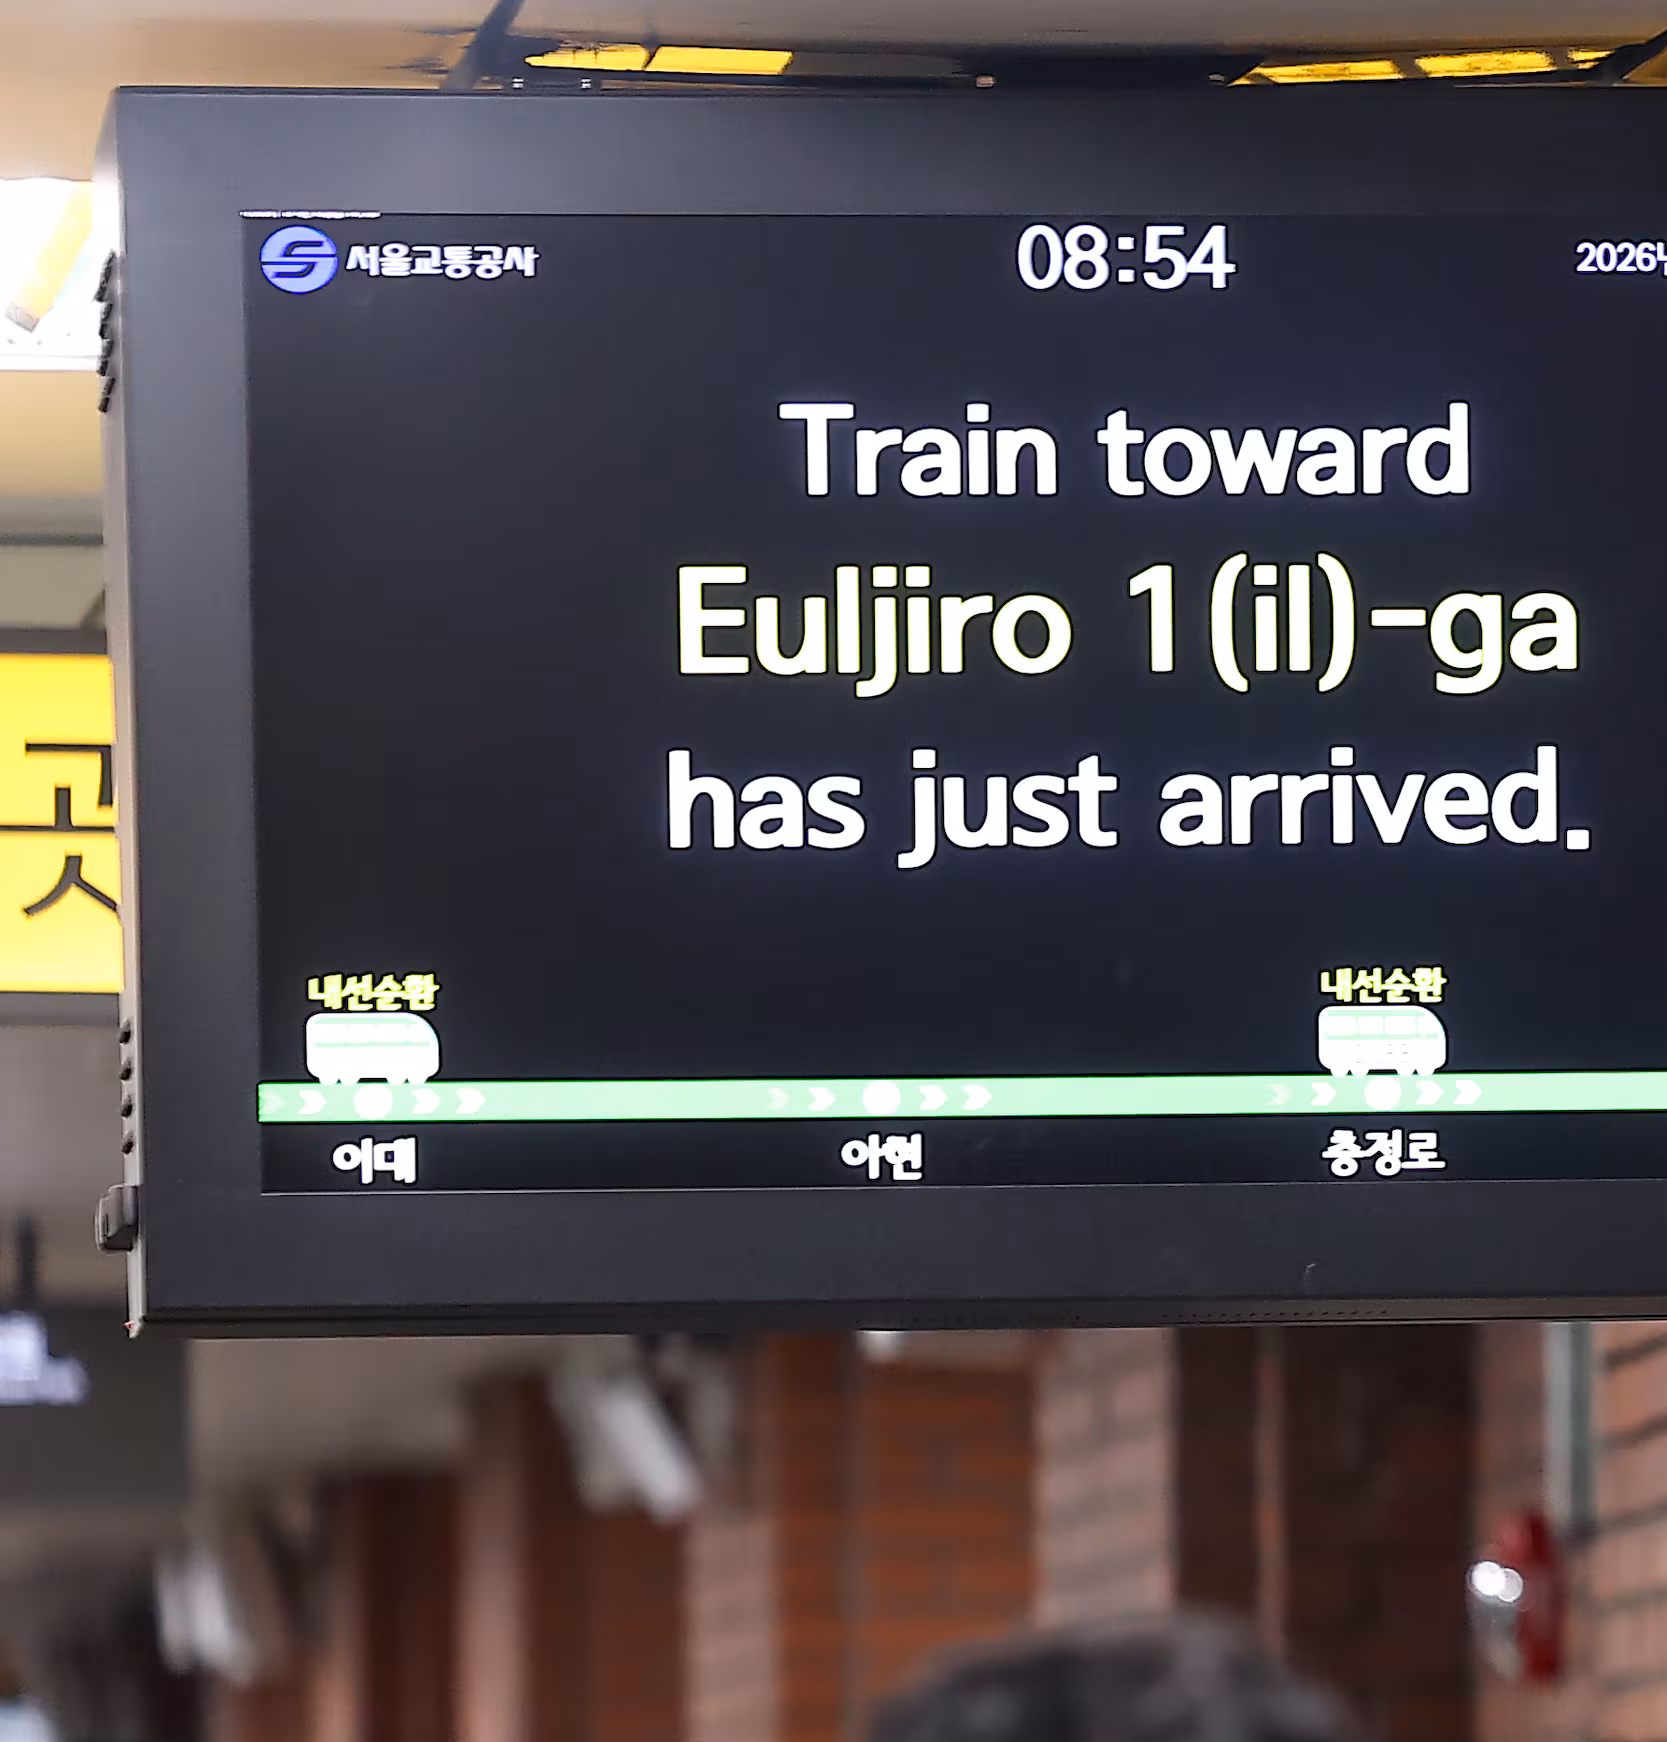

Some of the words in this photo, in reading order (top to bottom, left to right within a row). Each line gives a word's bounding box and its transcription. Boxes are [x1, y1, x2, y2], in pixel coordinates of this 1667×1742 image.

[345, 242, 540, 279] 서울교통공사
[1017, 224, 1236, 290] 08:54
[779, 402, 1057, 497] Train
[1097, 402, 1469, 496] toward
[679, 566, 1072, 698] Euljiro
[1129, 553, 1577, 694] 1(il)-ga
[668, 750, 865, 849] has
[897, 749, 1117, 869] just
[1159, 745, 1590, 850] arrived.
[308, 973, 440, 1011] 내선순환
[1320, 966, 1447, 1004] 내선순환
[332, 1137, 416, 1184] 이대
[841, 1133, 922, 1181] 아현
[1321, 1129, 1446, 1177] 충정로
